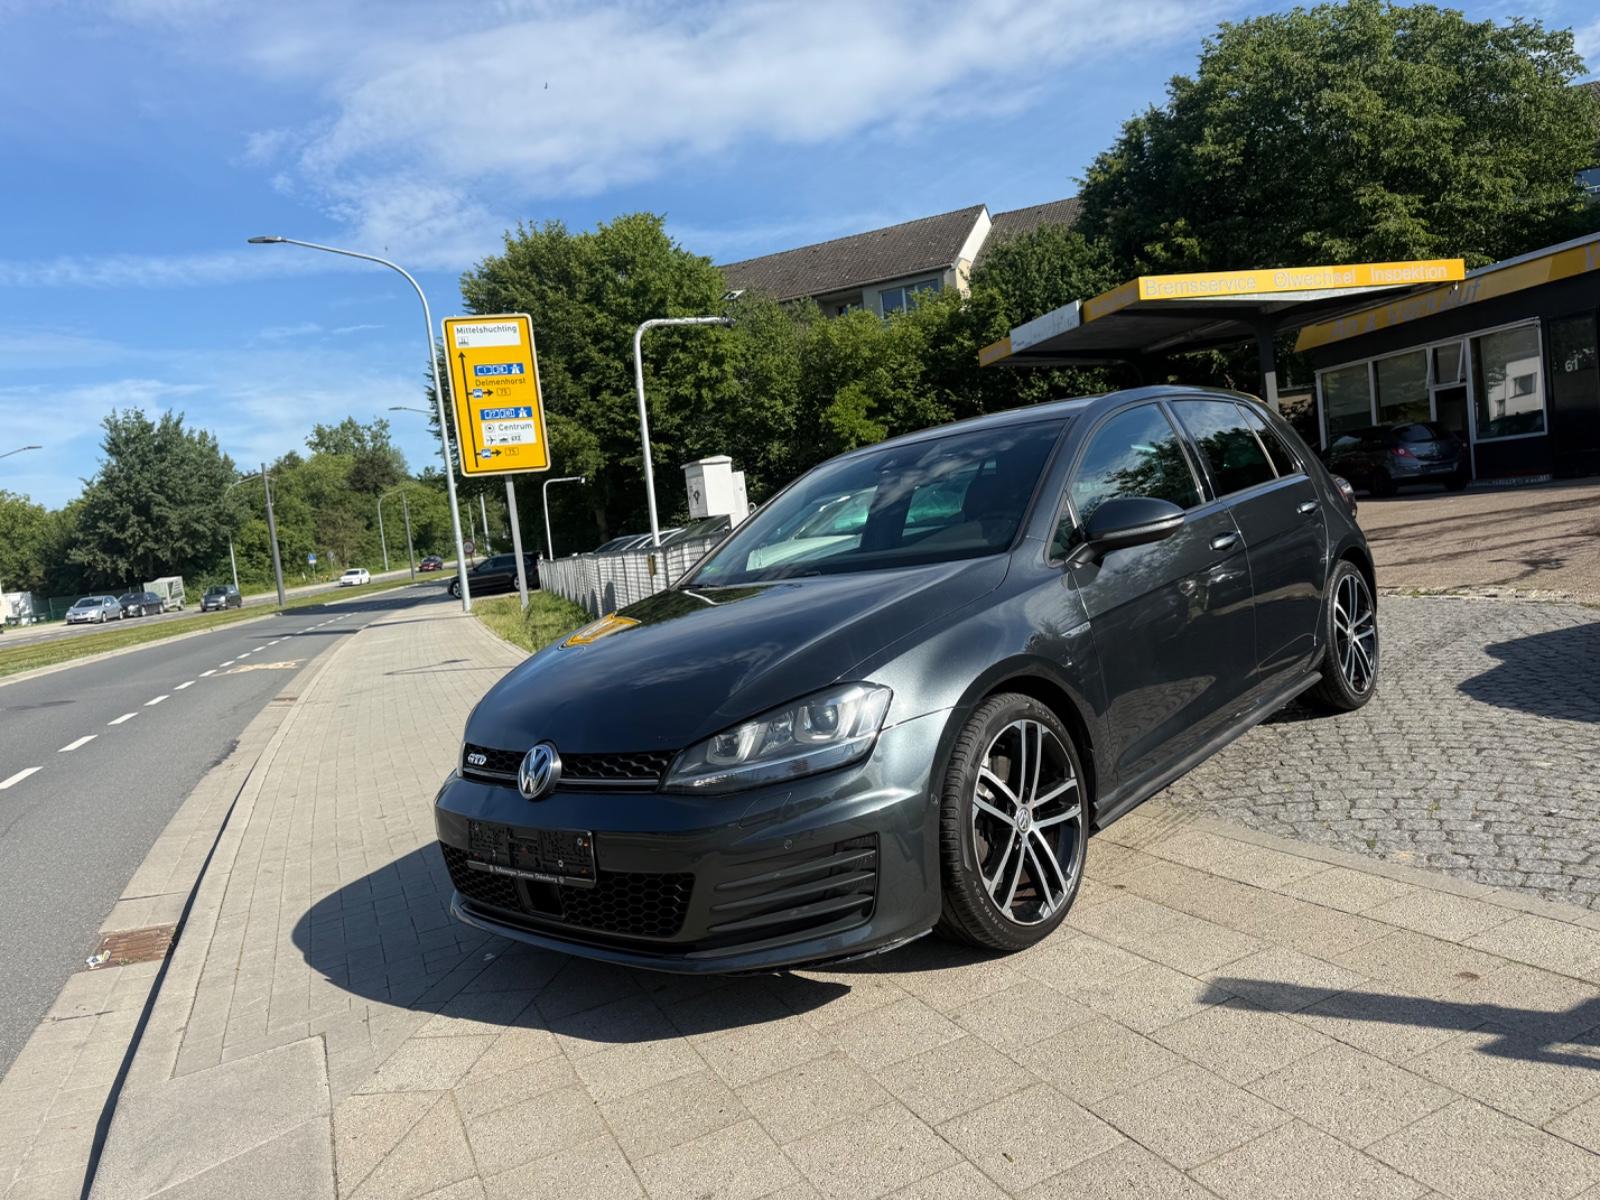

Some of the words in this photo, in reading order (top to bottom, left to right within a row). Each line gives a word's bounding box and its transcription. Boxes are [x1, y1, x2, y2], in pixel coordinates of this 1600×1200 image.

[1145, 275, 1256, 297] Bremsservice
[456, 325, 517, 335] Mittelshuchting
[475, 377, 526, 387] Delmenhorst
[498, 423, 532, 431] Centrum
